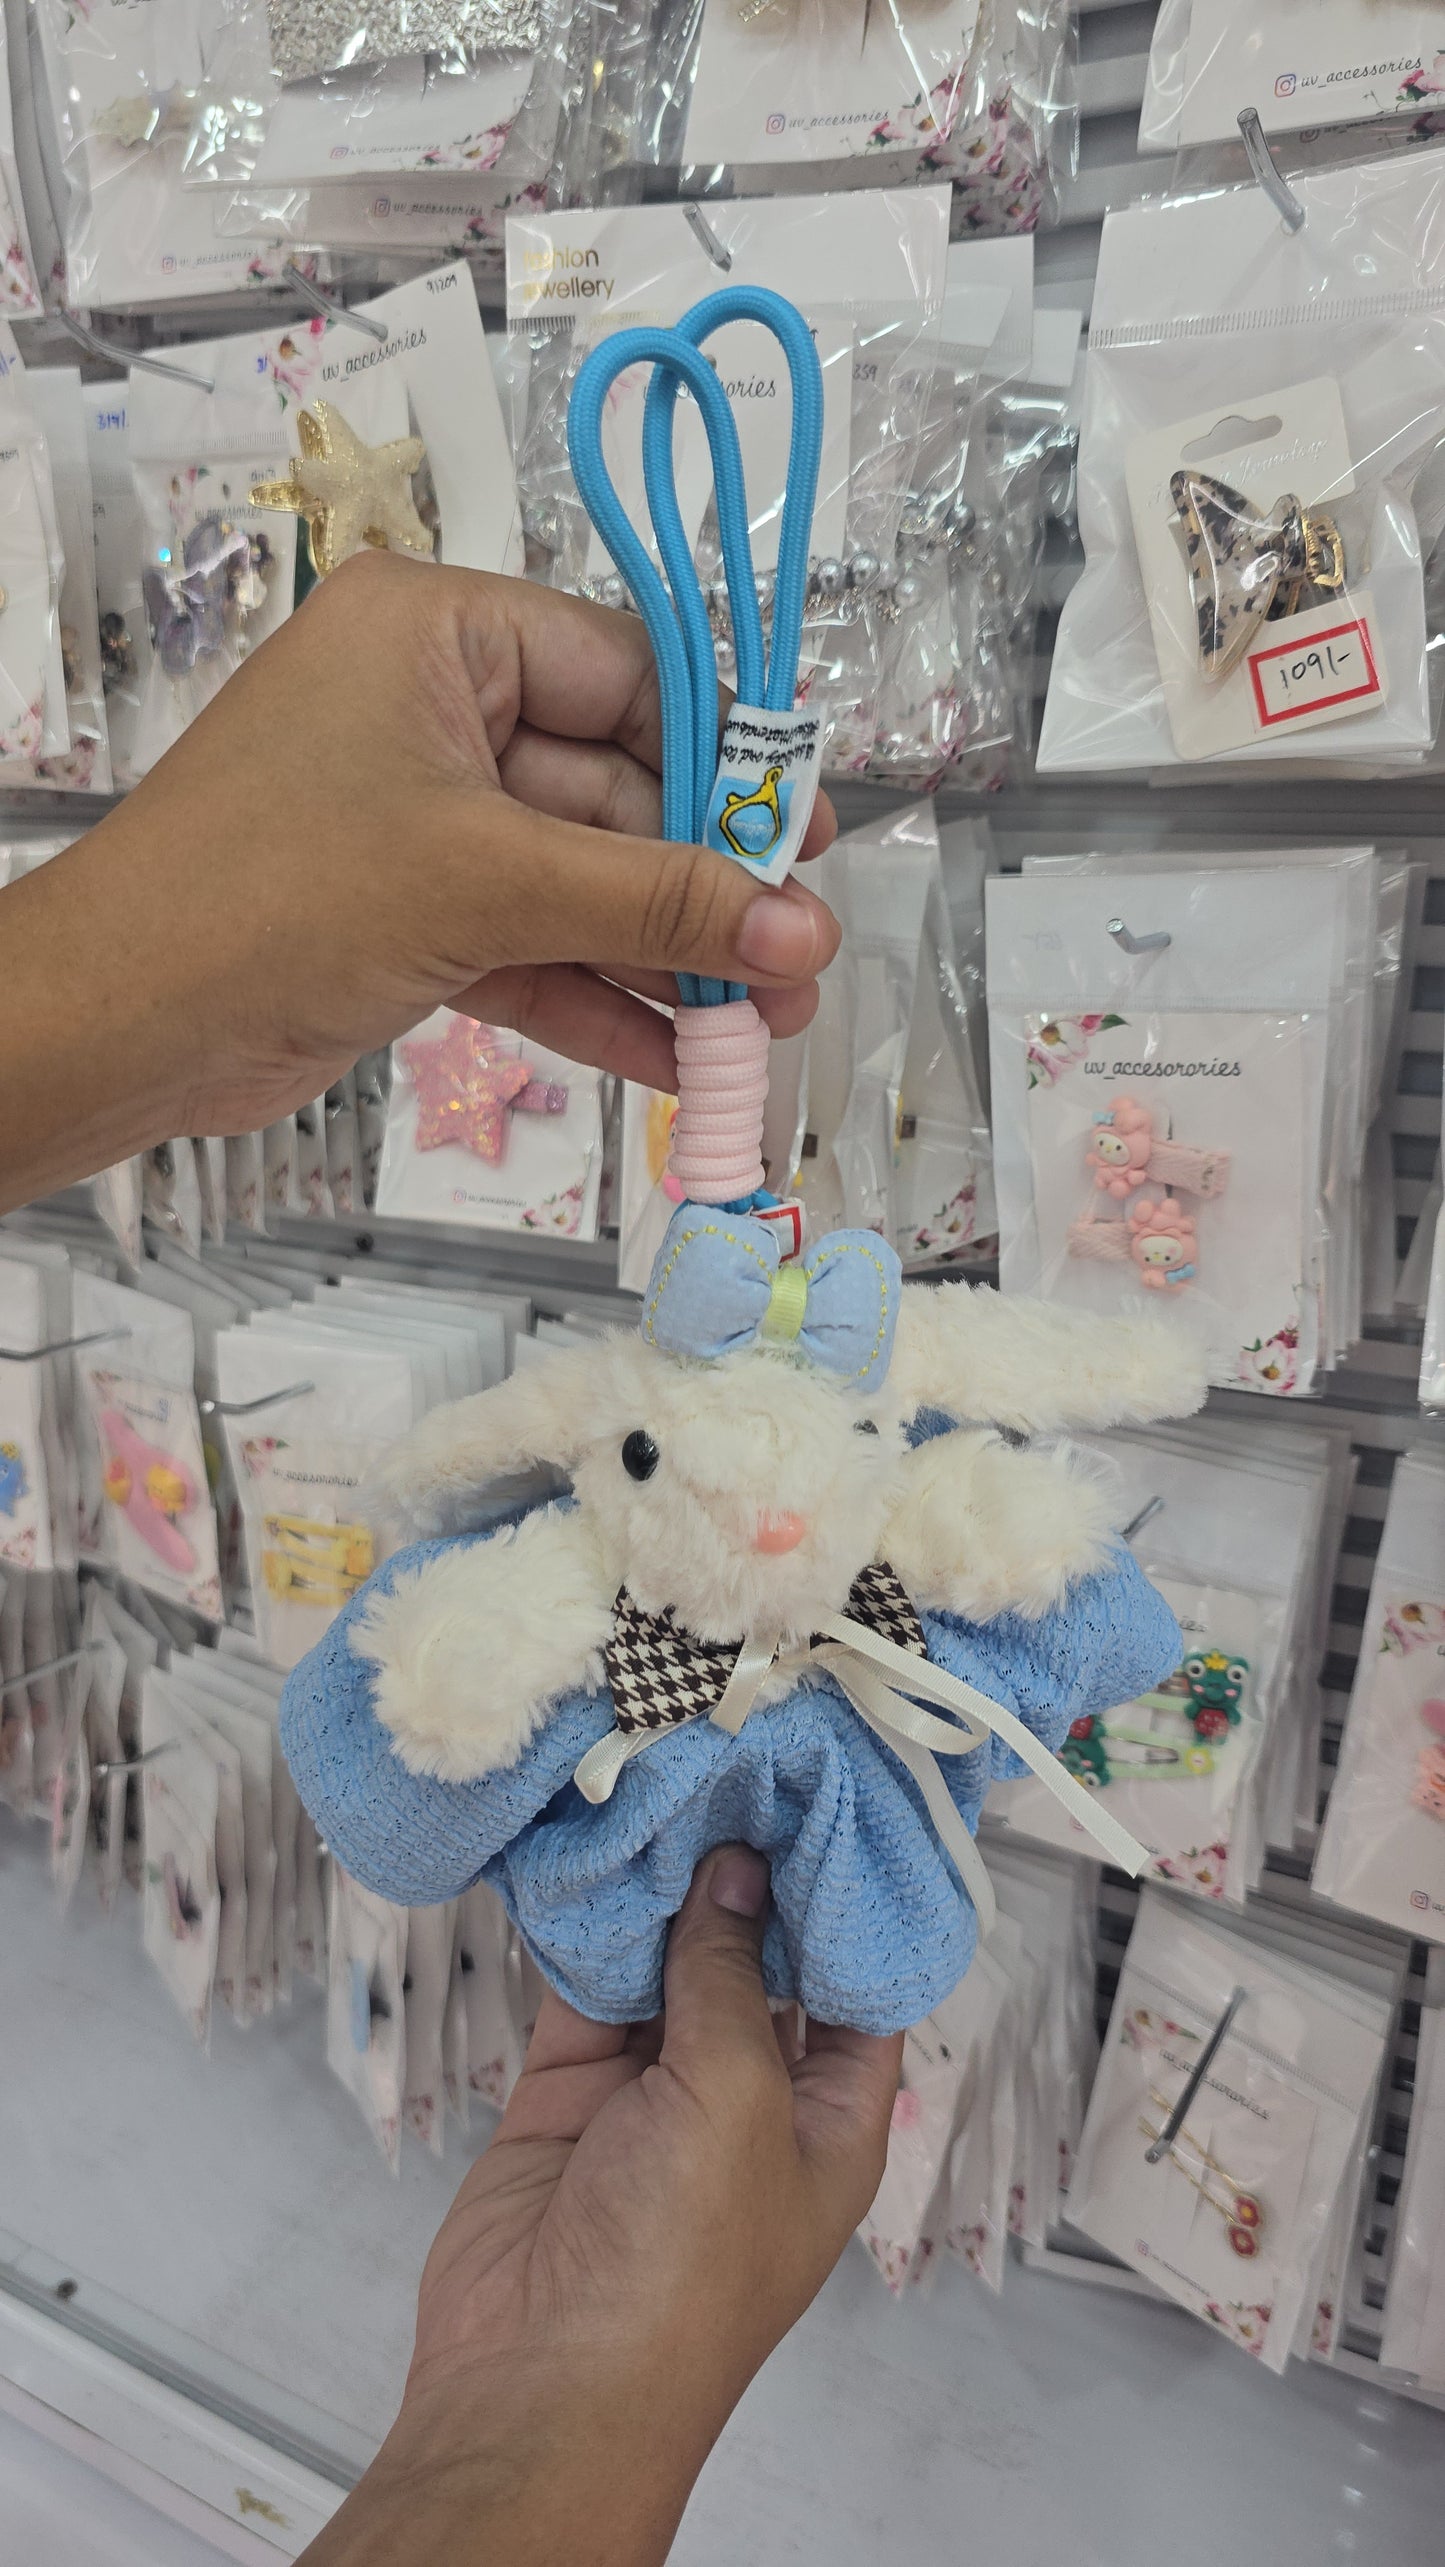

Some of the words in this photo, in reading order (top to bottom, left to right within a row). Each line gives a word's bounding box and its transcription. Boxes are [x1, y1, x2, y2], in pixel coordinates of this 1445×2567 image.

[1301, 57, 1422, 88] uv_accessories
[788, 110, 889, 131] uv_accessories
[322, 328, 427, 382] uv_accessories
